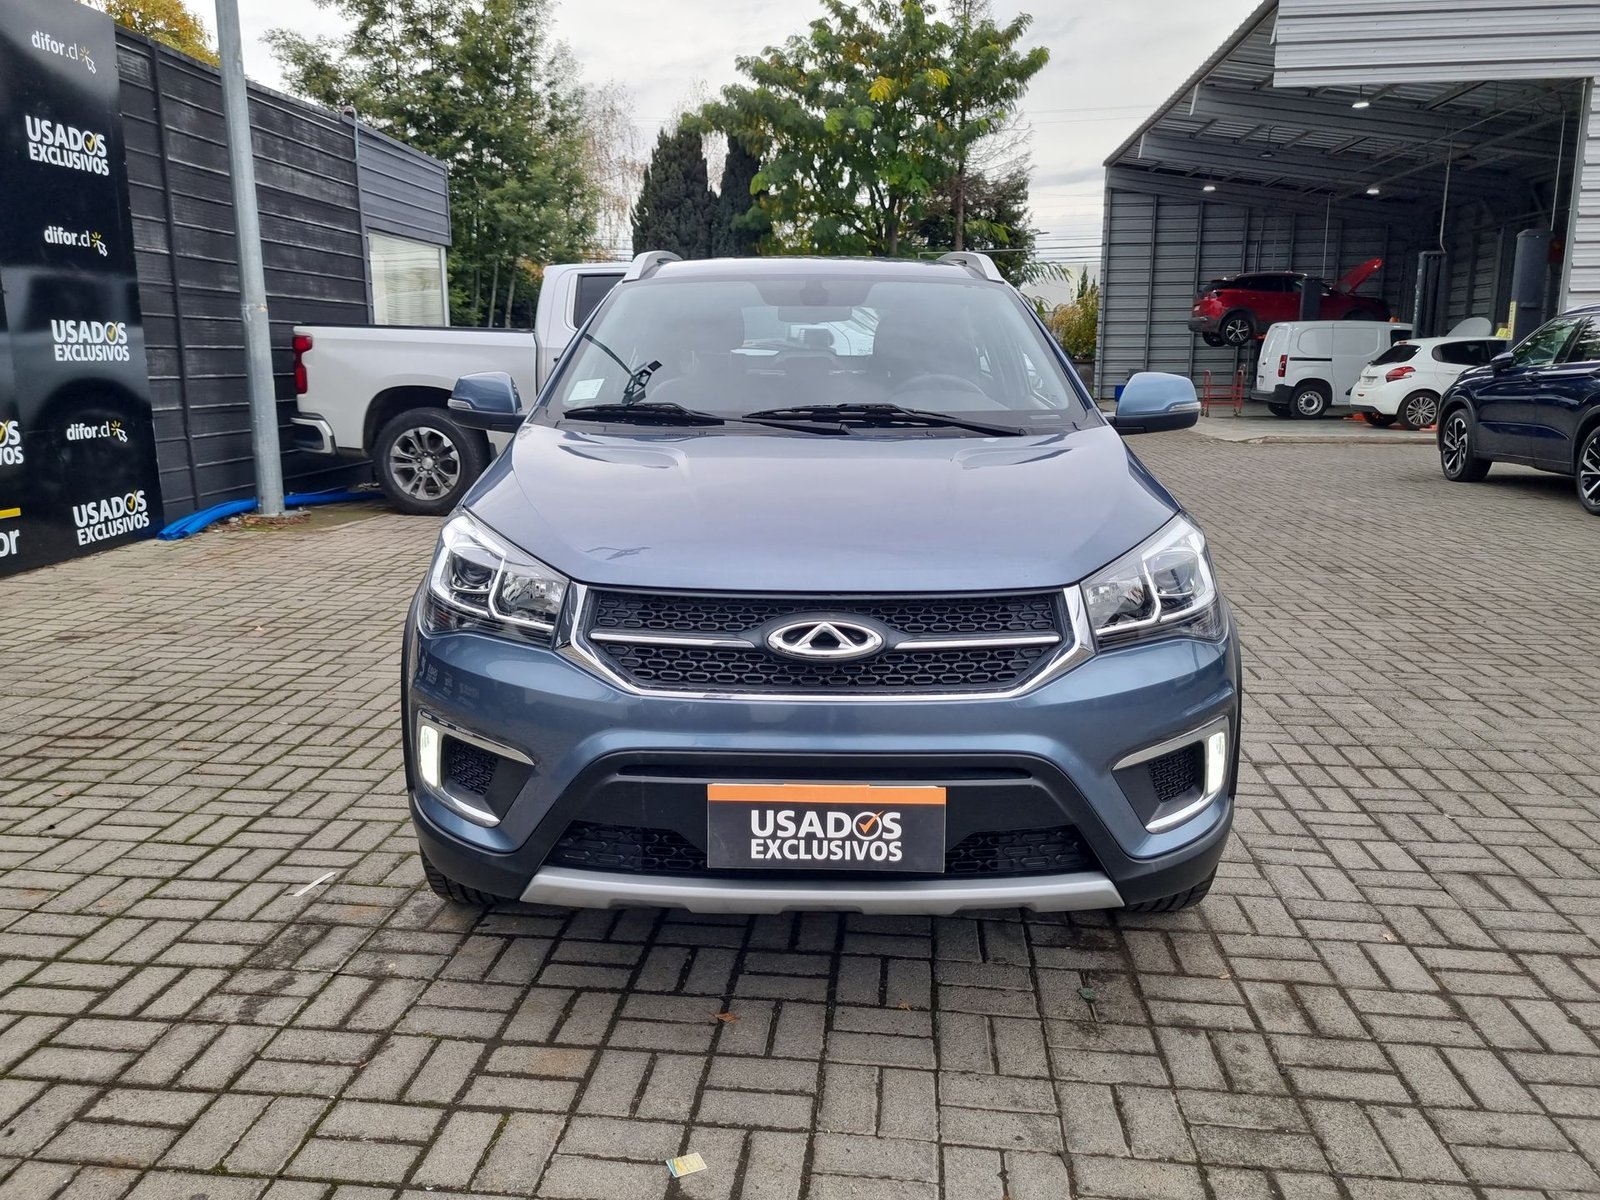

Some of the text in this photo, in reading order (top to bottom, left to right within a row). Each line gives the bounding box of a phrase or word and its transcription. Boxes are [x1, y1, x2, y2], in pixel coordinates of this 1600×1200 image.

[31, 31, 78, 60] difor.cl
[25, 115, 107, 157] USADOS
[28, 142, 109, 176] EXCLUSIVOS
[44, 226, 90, 247] difor.cl
[51, 320, 127, 344] USADOS
[54, 345, 129, 361] EXCLUSIVOS
[66, 421, 110, 441] difor.cl
[73, 490, 147, 528] USADOS
[77, 512, 149, 546] EXCLUSIVOS
[751, 810, 902, 840] USADOS
[751, 839, 902, 861] EXCLUSIVOS
